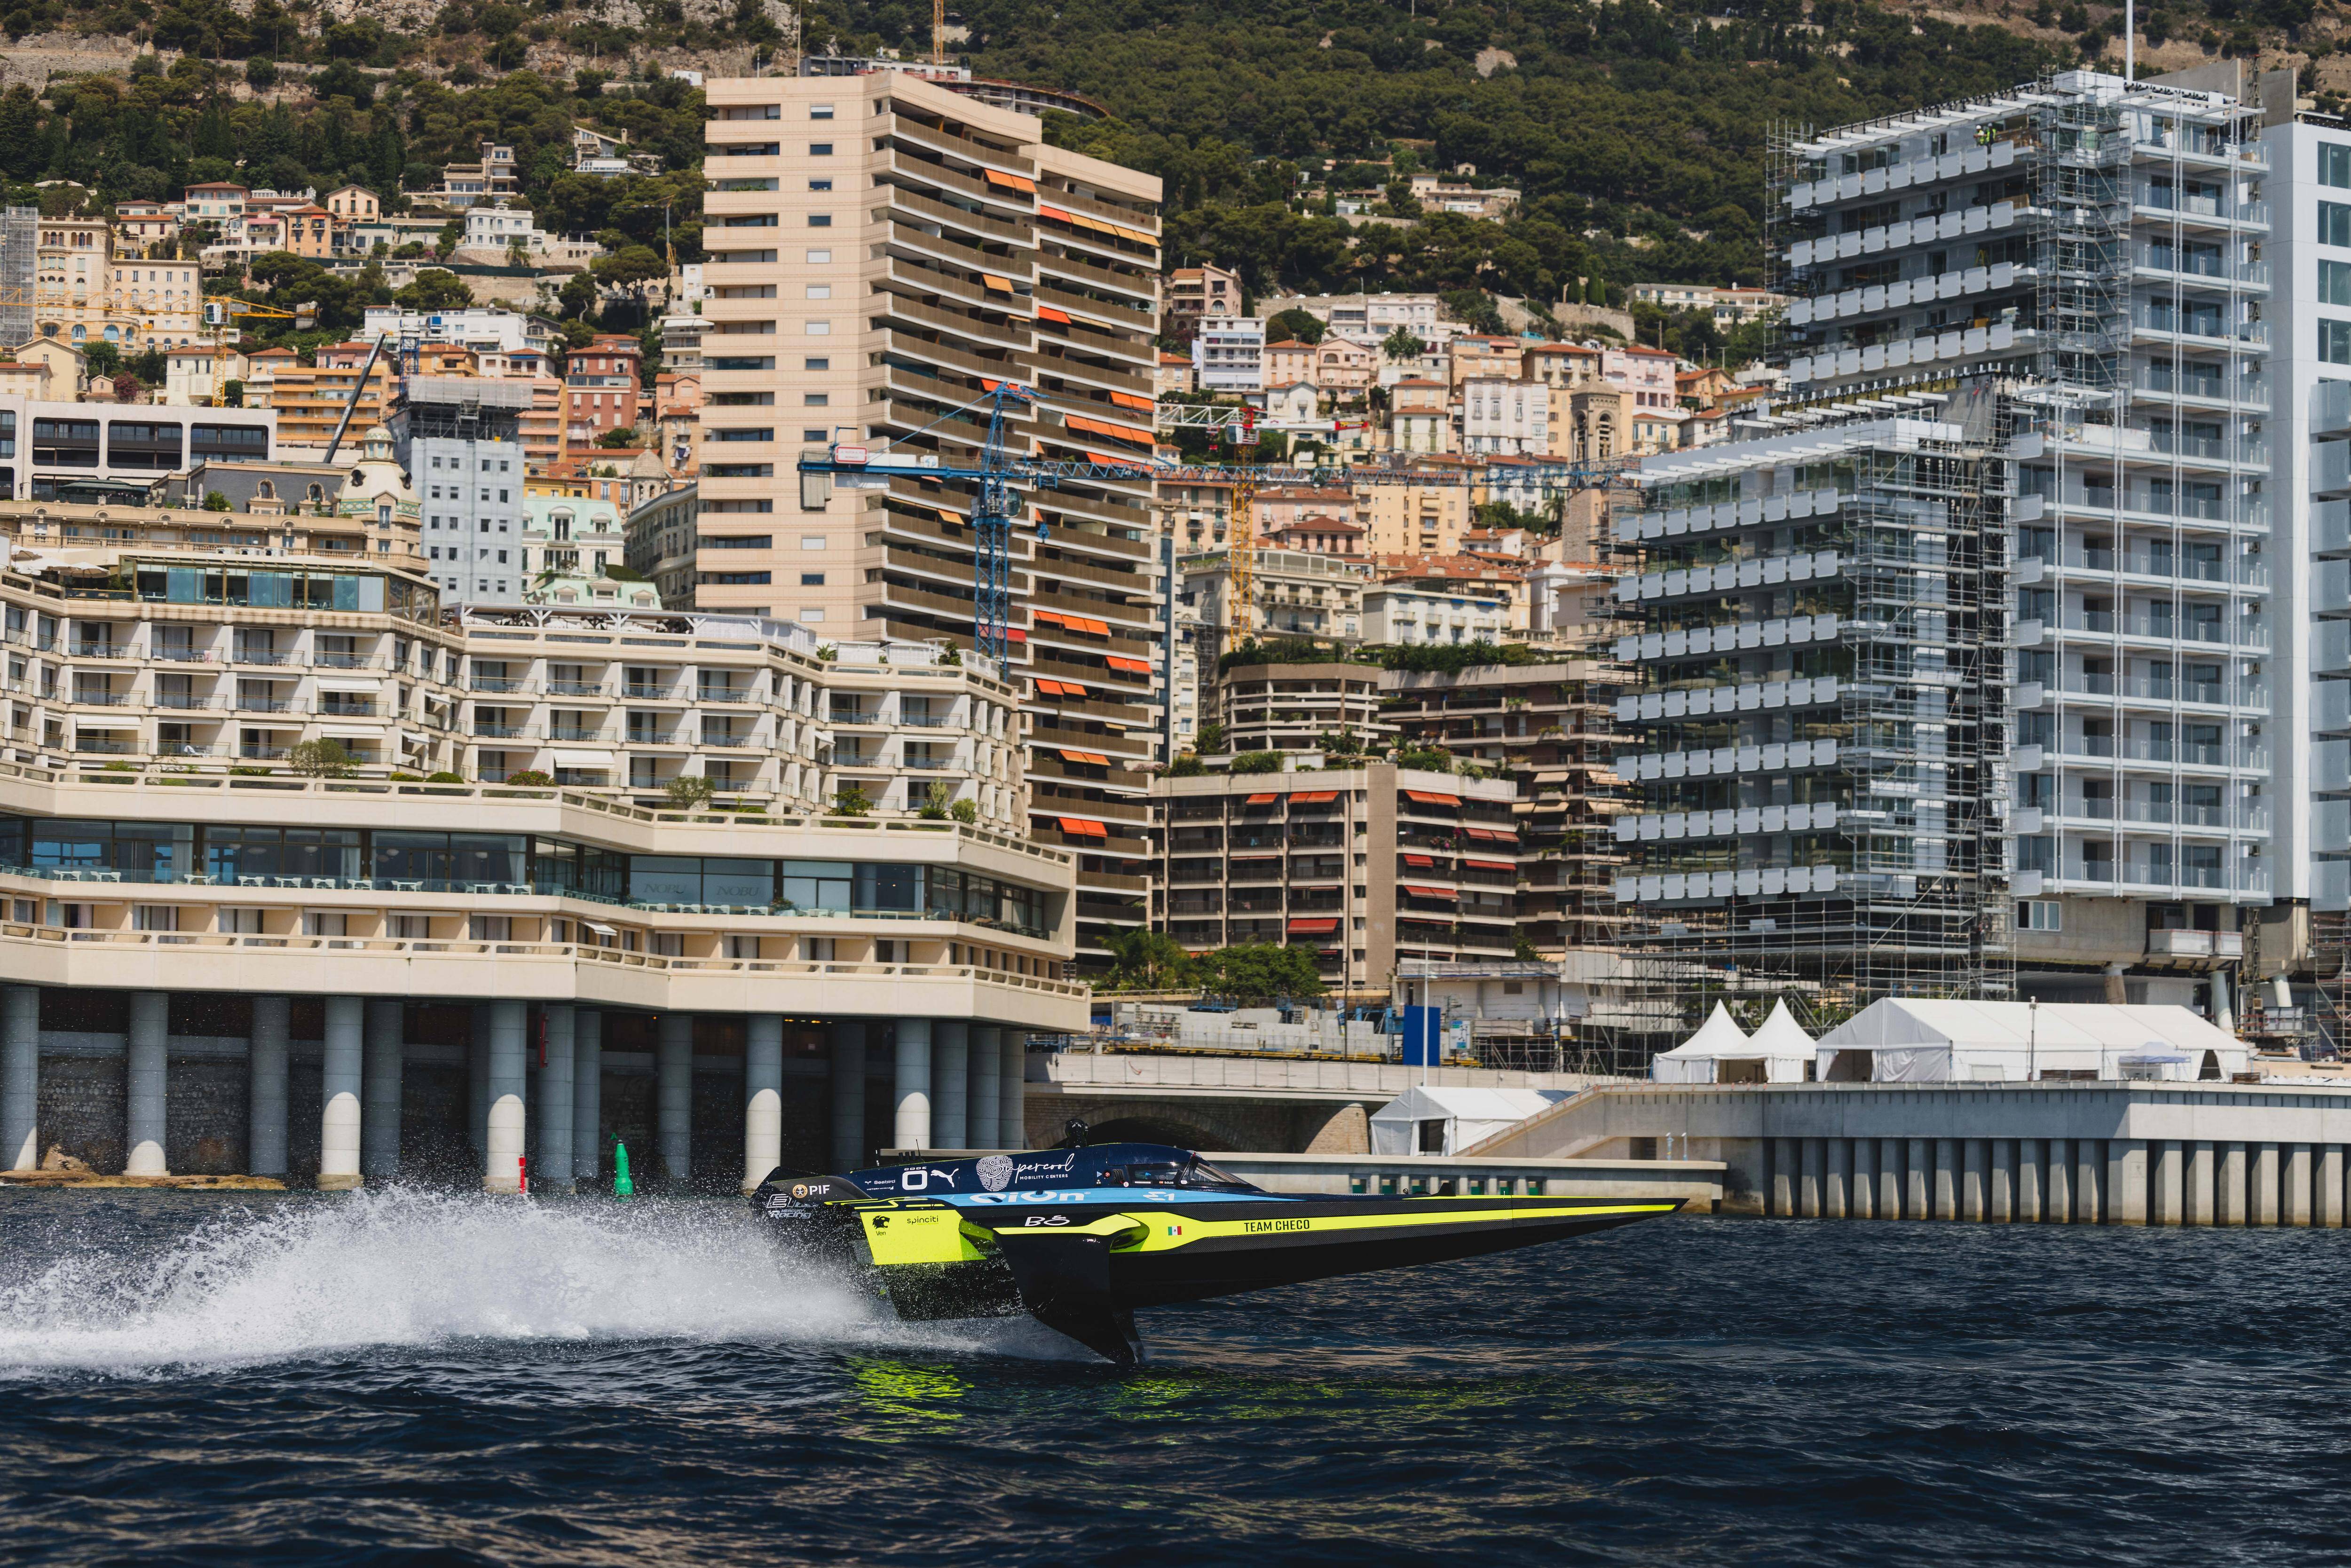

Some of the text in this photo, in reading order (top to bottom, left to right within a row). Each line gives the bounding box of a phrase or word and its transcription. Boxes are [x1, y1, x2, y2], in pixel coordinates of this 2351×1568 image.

[643, 883, 687, 894] NOBU
[717, 886, 761, 896] NOBU
[809, 1184, 830, 1195] PIF
[768, 1210, 812, 1219] Racing
[907, 1215, 939, 1225] spinciti
[1276, 1220, 1310, 1230] CHECO
[1244, 1221, 1272, 1232] TEAM
